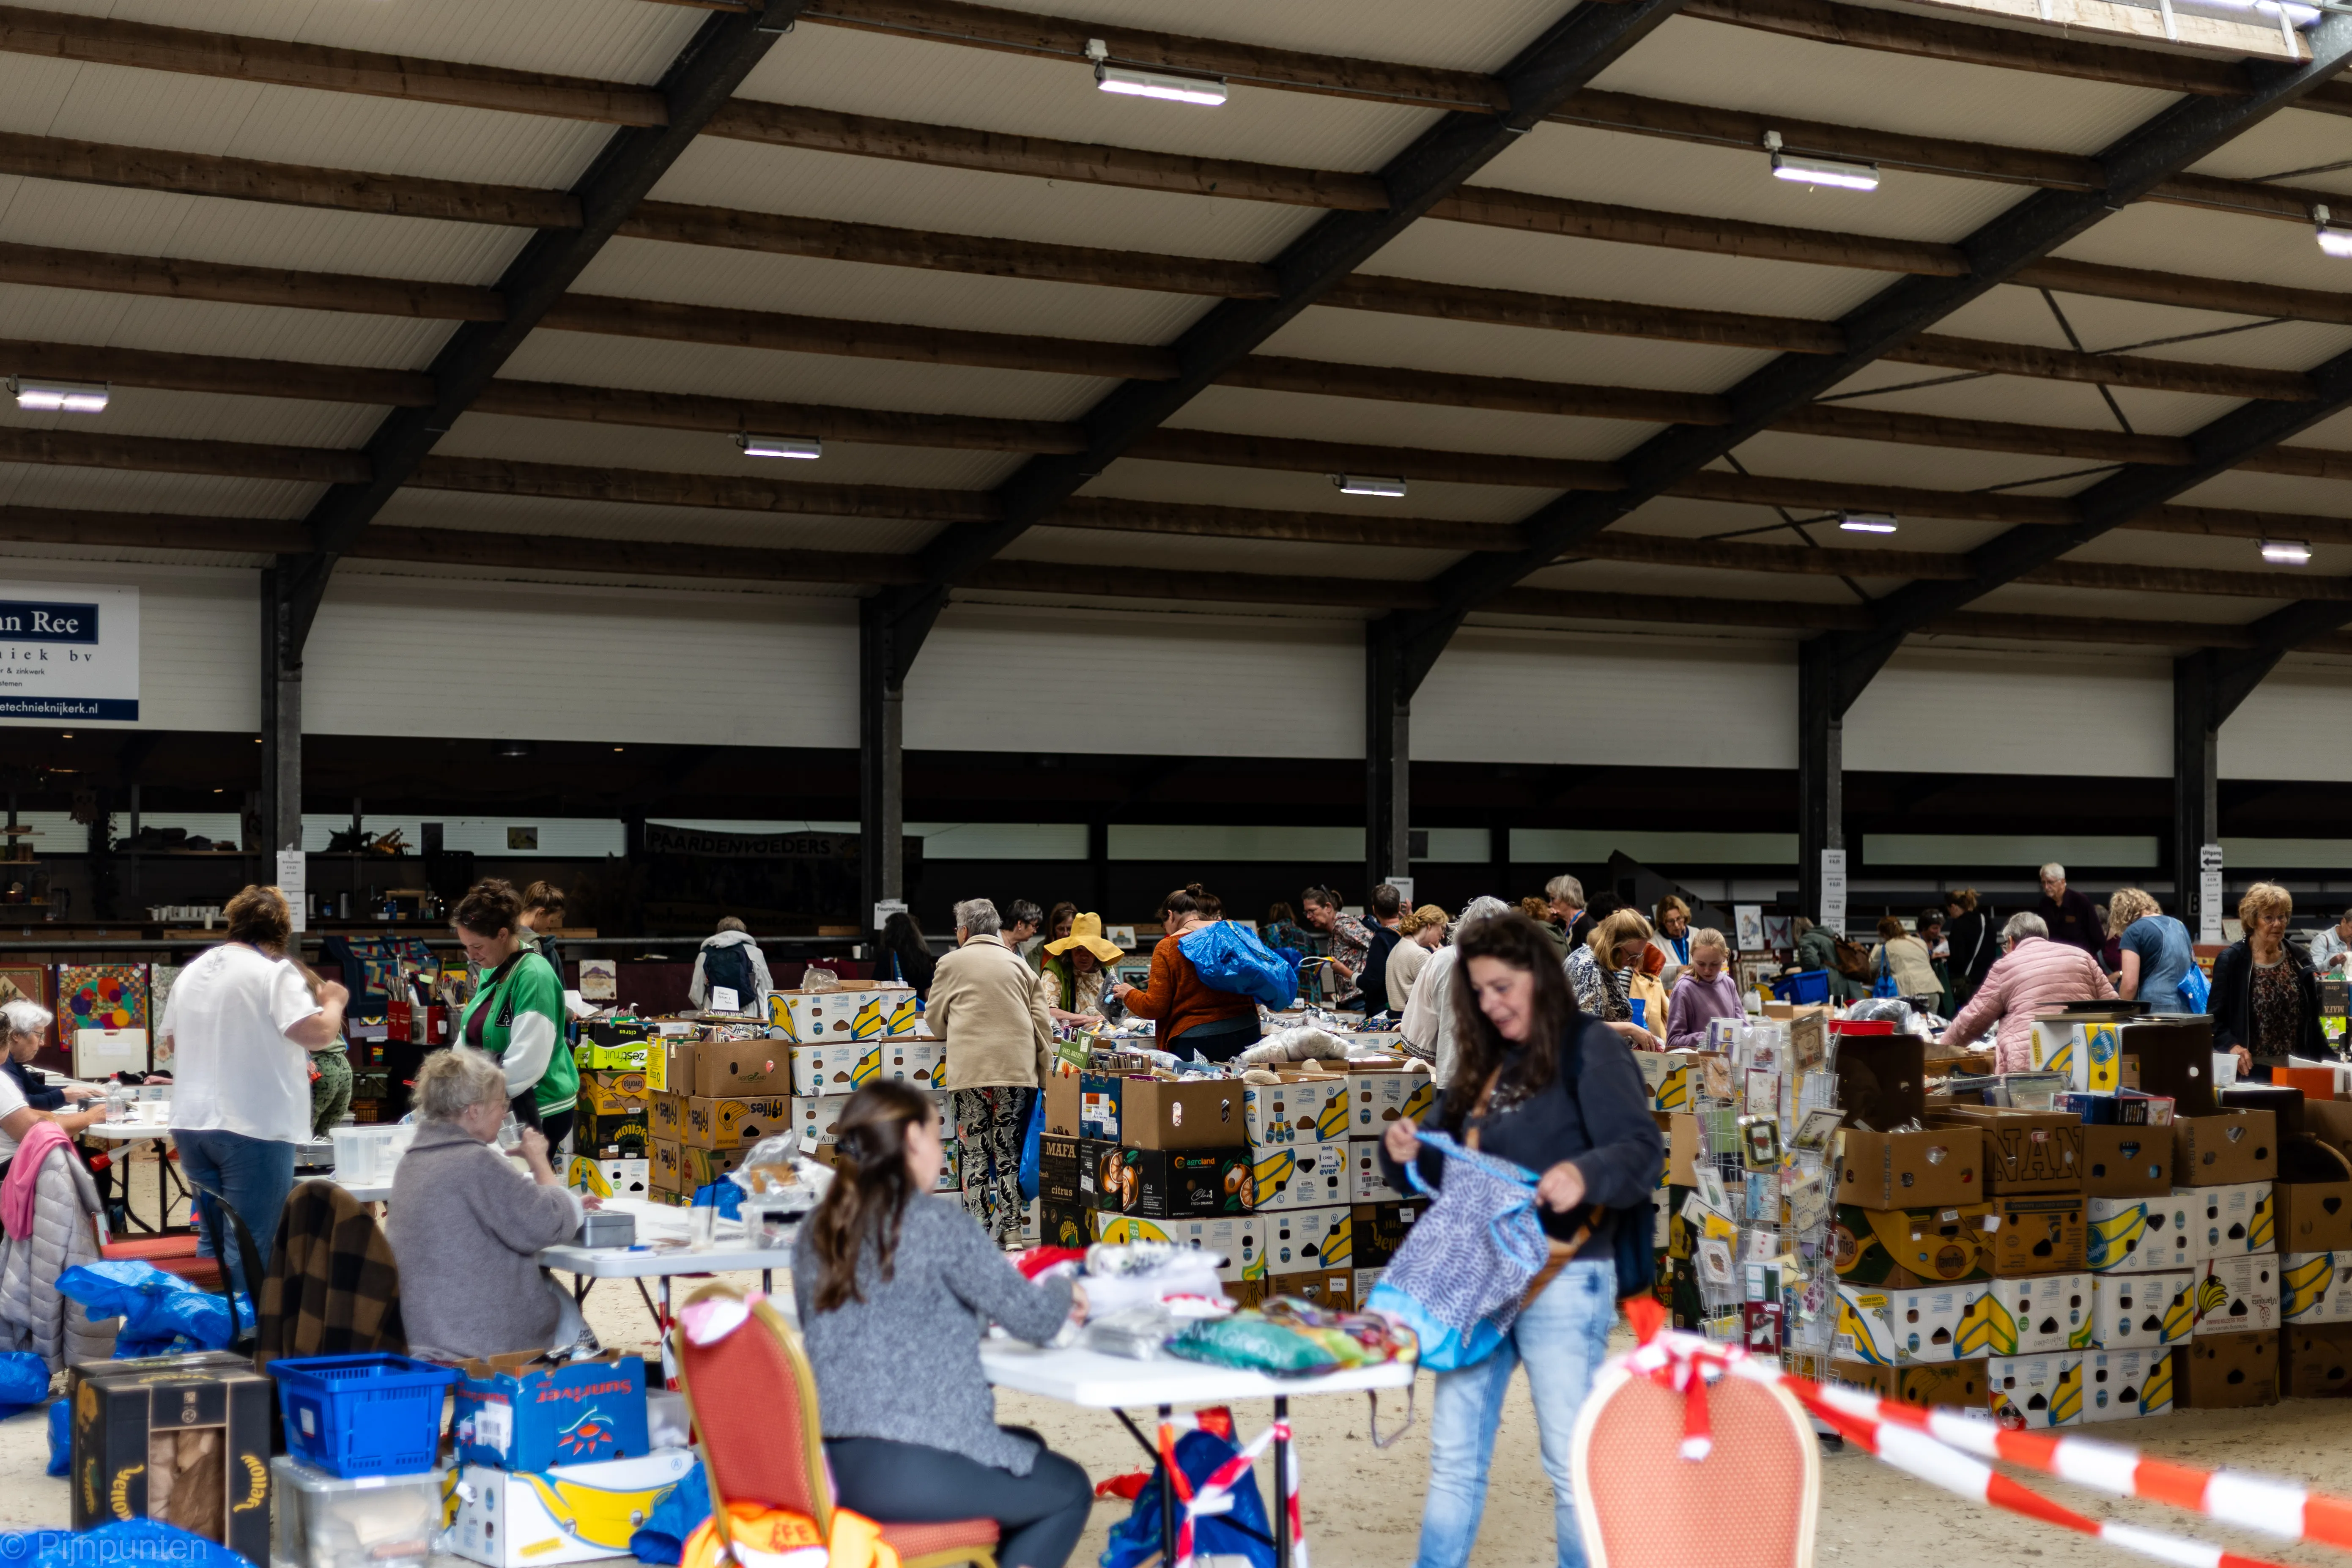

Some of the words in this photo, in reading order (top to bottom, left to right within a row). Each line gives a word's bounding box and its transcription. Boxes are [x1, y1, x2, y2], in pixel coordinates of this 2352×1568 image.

[31, 611, 79, 633] Ree
[70, 650, 91, 662] bv
[2191, 893, 2199, 914] B
[2100, 1031, 2114, 1058] Chiquita
[603, 1050, 644, 1063] zestfruit
[1062, 1047, 1072, 1055] SNEL
[1070, 1050, 1084, 1060] BREIEN
[623, 1080, 643, 1089] favorita
[613, 1124, 650, 1146] yellow
[1046, 1142, 1076, 1158] MAFA
[1187, 1157, 1215, 1166] agroland
[1051, 1185, 1073, 1197] citrus
[1938, 1253, 1964, 1269] favorita
[2252, 1297, 2278, 1306] Mariquita
[536, 1379, 632, 1403] Sunriver
[233, 1453, 267, 1513] yellow
